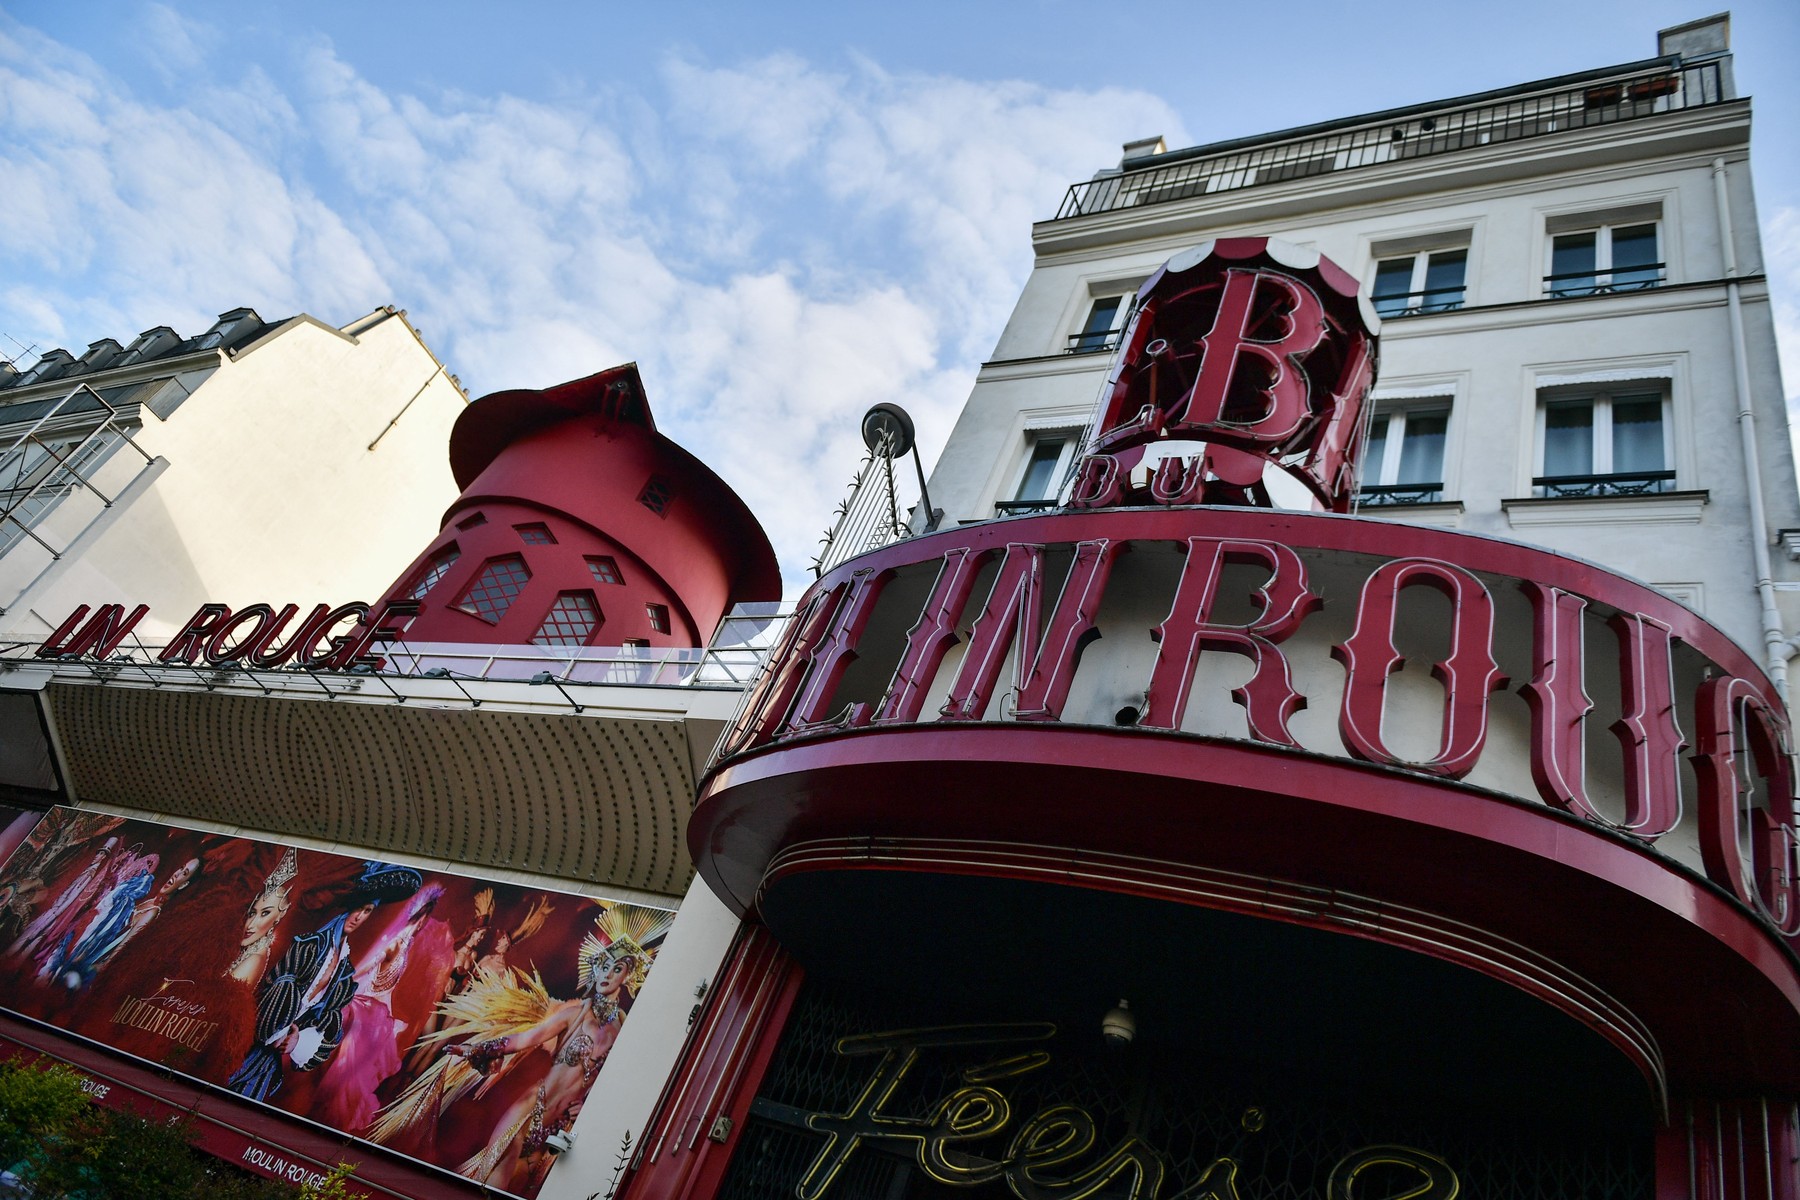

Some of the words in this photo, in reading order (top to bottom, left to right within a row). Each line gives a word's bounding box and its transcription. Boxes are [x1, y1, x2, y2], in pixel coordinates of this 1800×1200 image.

[1066, 454, 1214, 508] DU
[157, 601, 428, 672] ROUGE
[109, 994, 168, 1034] MOULIN
[160, 1012, 220, 1053] ROUGE
[241, 1145, 289, 1176] MOULIN
[284, 1163, 328, 1191] ROUGE
